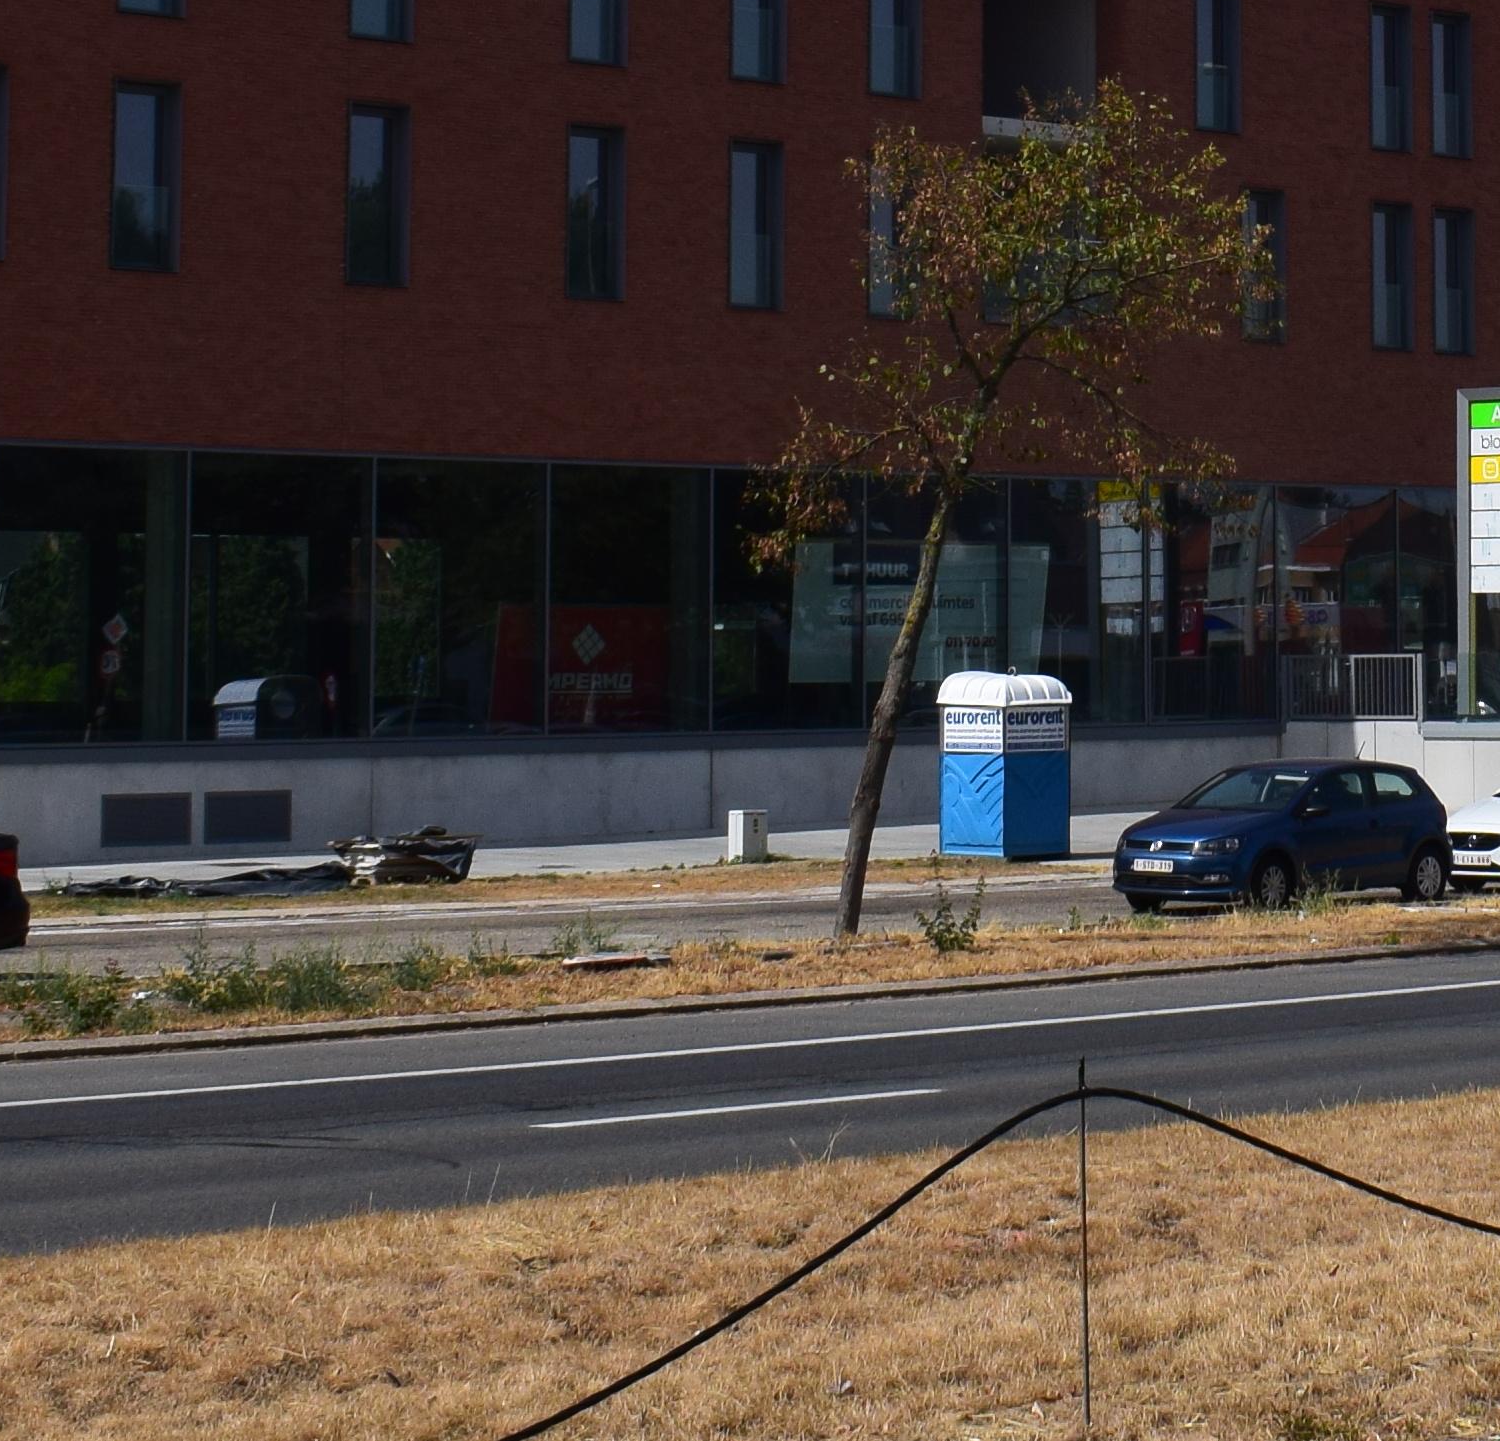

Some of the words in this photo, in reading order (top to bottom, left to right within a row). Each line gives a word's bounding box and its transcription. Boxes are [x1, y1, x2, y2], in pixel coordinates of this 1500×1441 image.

[867, 563, 909, 578] HUUR
[548, 672, 633, 689] MPERMO
[946, 709, 1001, 725] eurorent
[1008, 708, 1063, 726] eurorent
